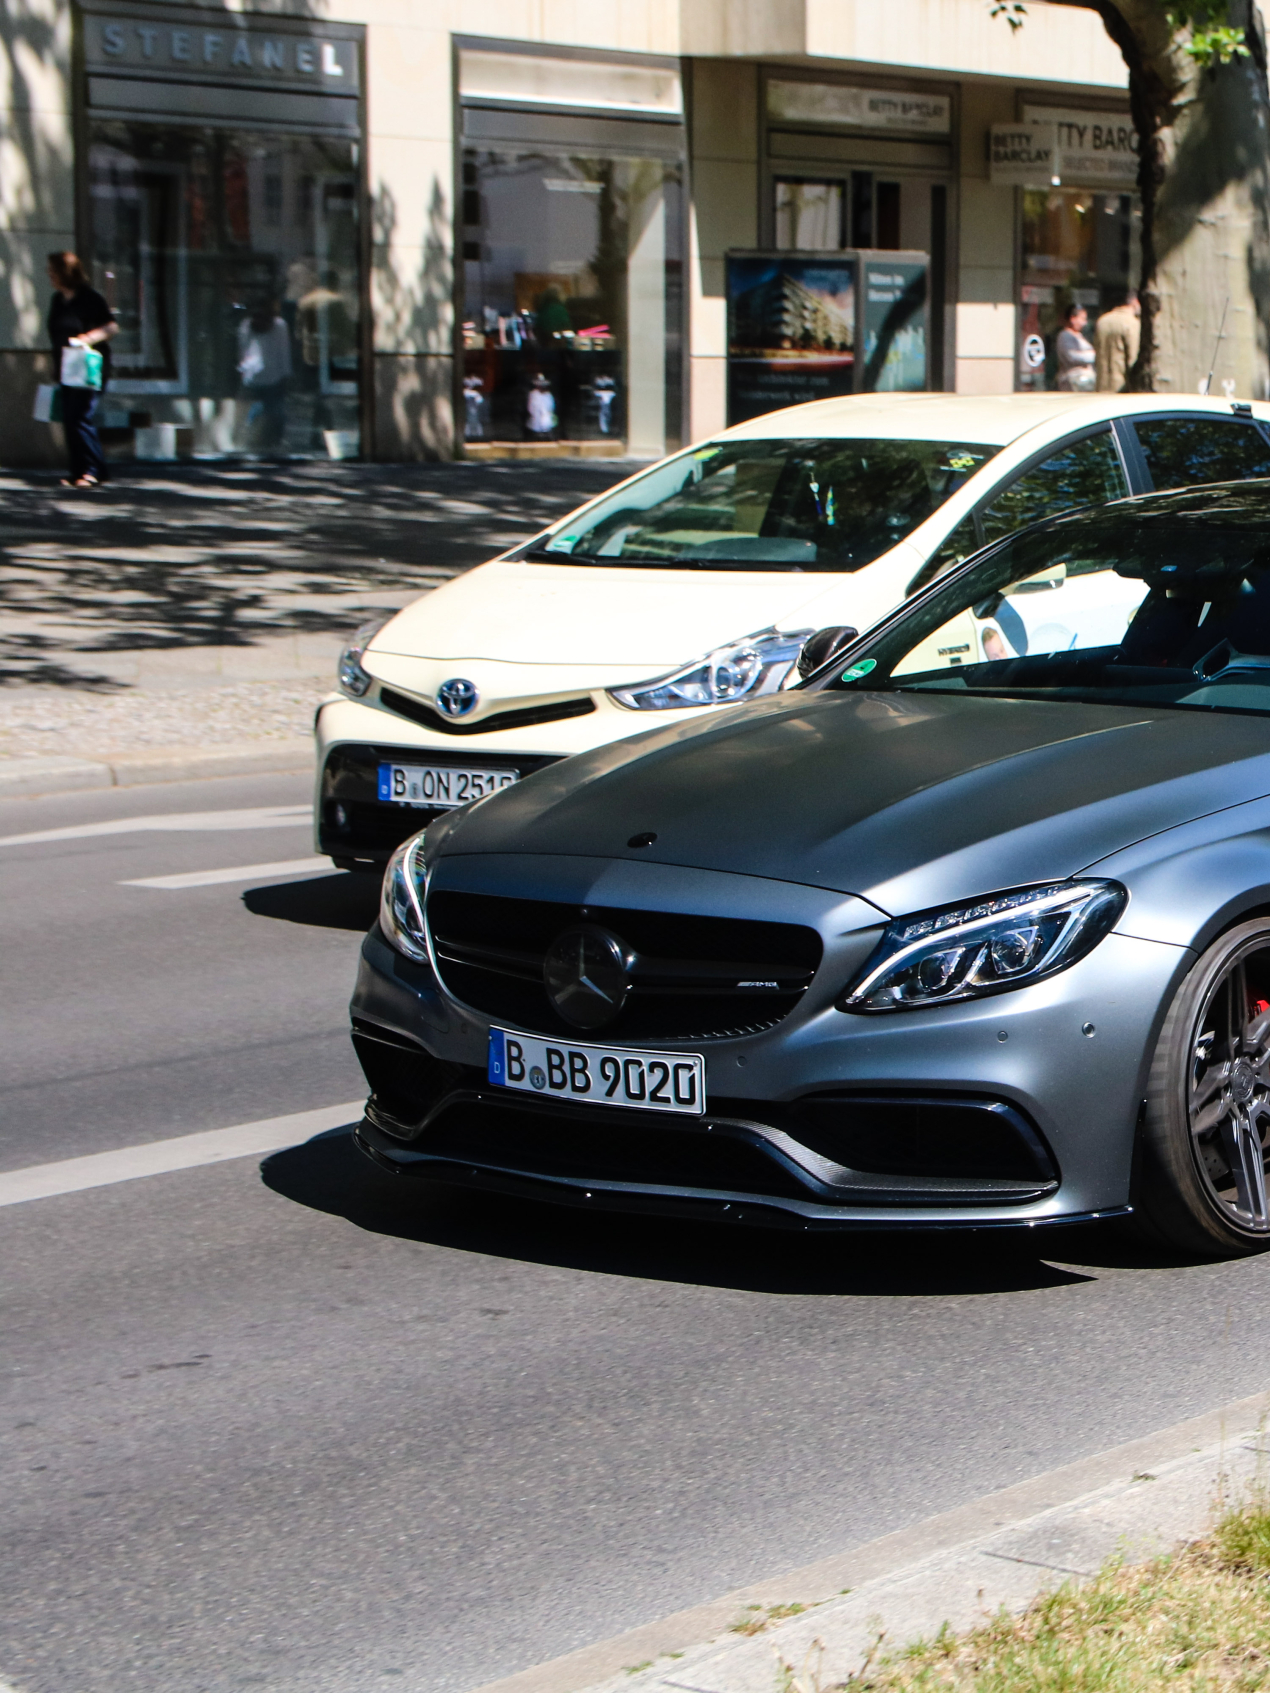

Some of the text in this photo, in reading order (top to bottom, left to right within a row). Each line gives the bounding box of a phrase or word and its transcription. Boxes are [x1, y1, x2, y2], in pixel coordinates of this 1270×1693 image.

[103, 24, 344, 77] STEFANEL
[993, 132, 1032, 148] BETTY
[993, 149, 1050, 163] BARCLAY
[394, 769, 407, 797] B
[423, 770, 450, 800] ON
[494, 1061, 500, 1074] D
[506, 1039, 696, 1106] B BB 9020
